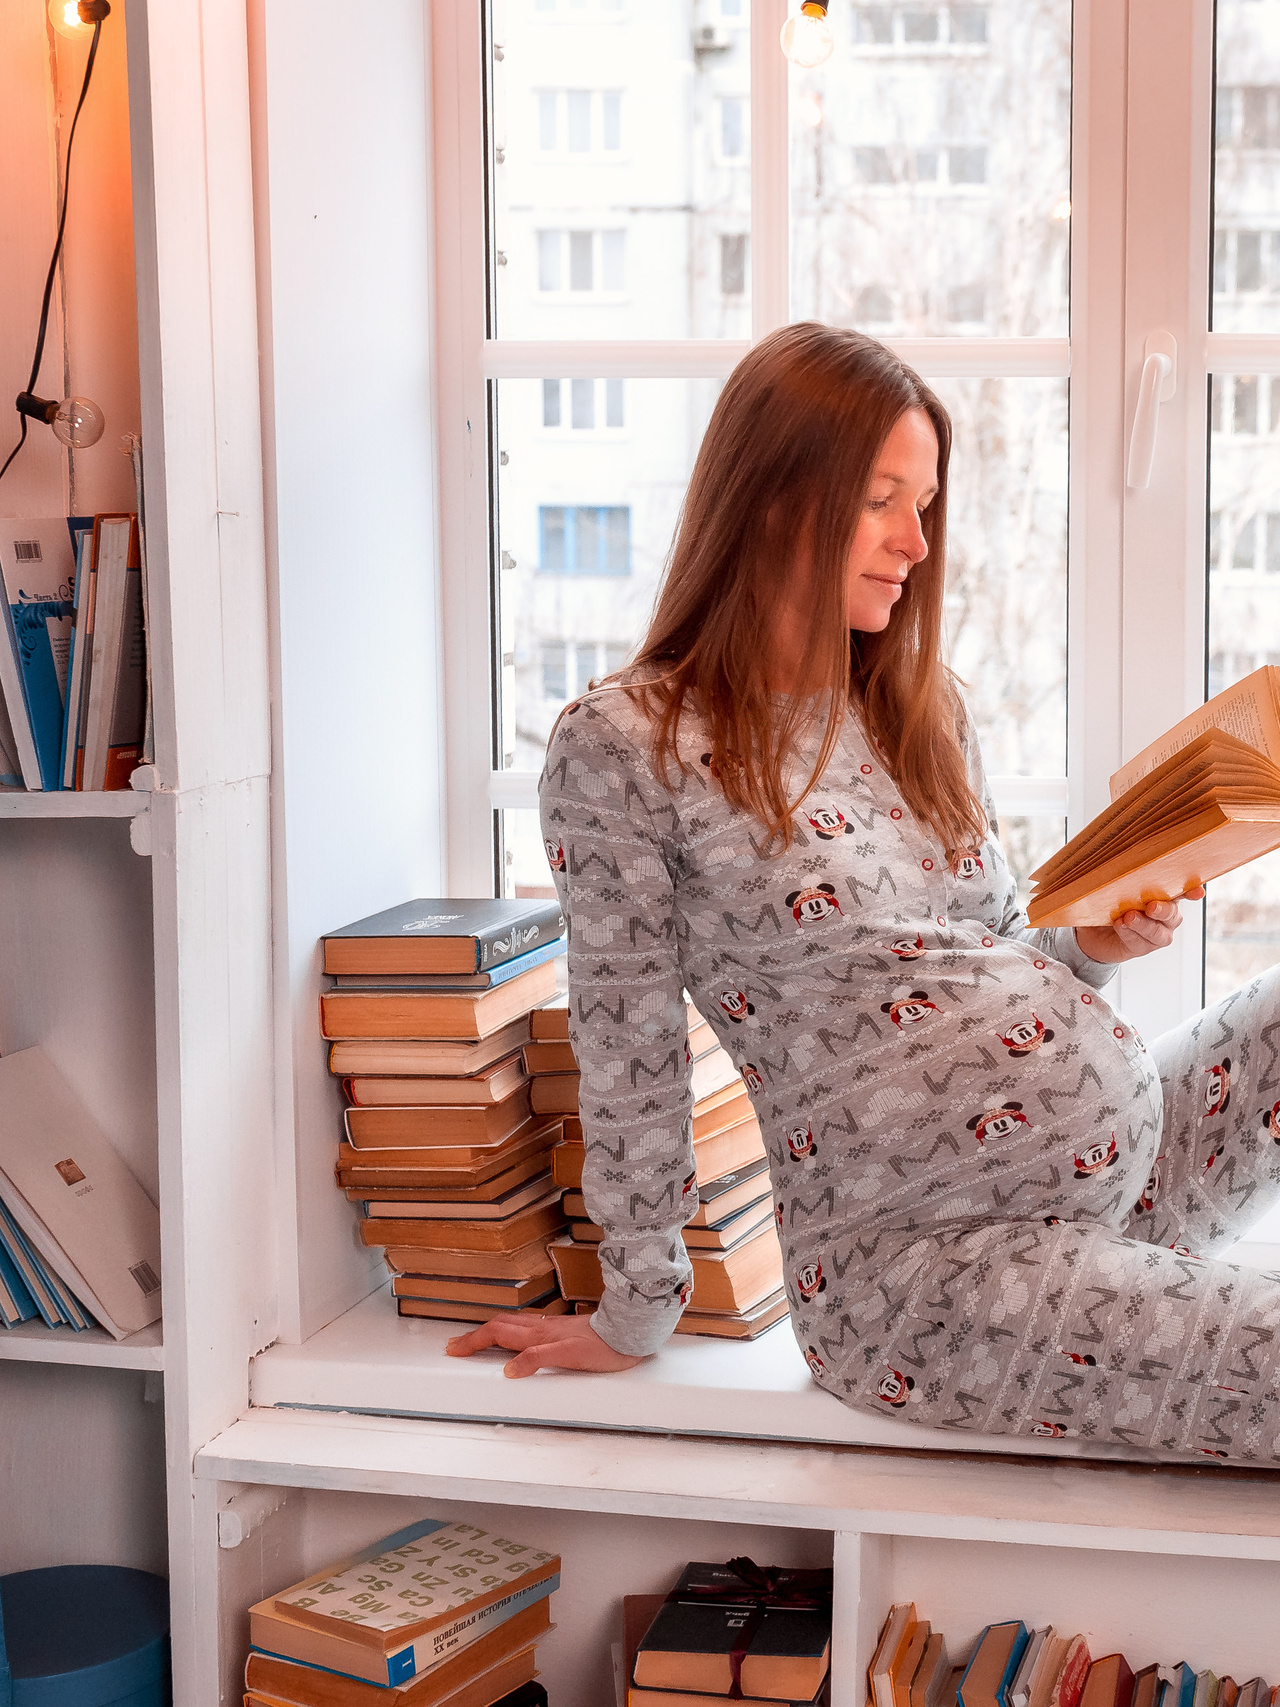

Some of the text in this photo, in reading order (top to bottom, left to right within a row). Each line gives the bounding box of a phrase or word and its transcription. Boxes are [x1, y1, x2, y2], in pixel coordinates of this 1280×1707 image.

[433, 1616, 476, 1646] НОВЕЙШАЯ
[478, 1594, 511, 1621] ИСТОРИЯ
[446, 1636, 459, 1649] век
